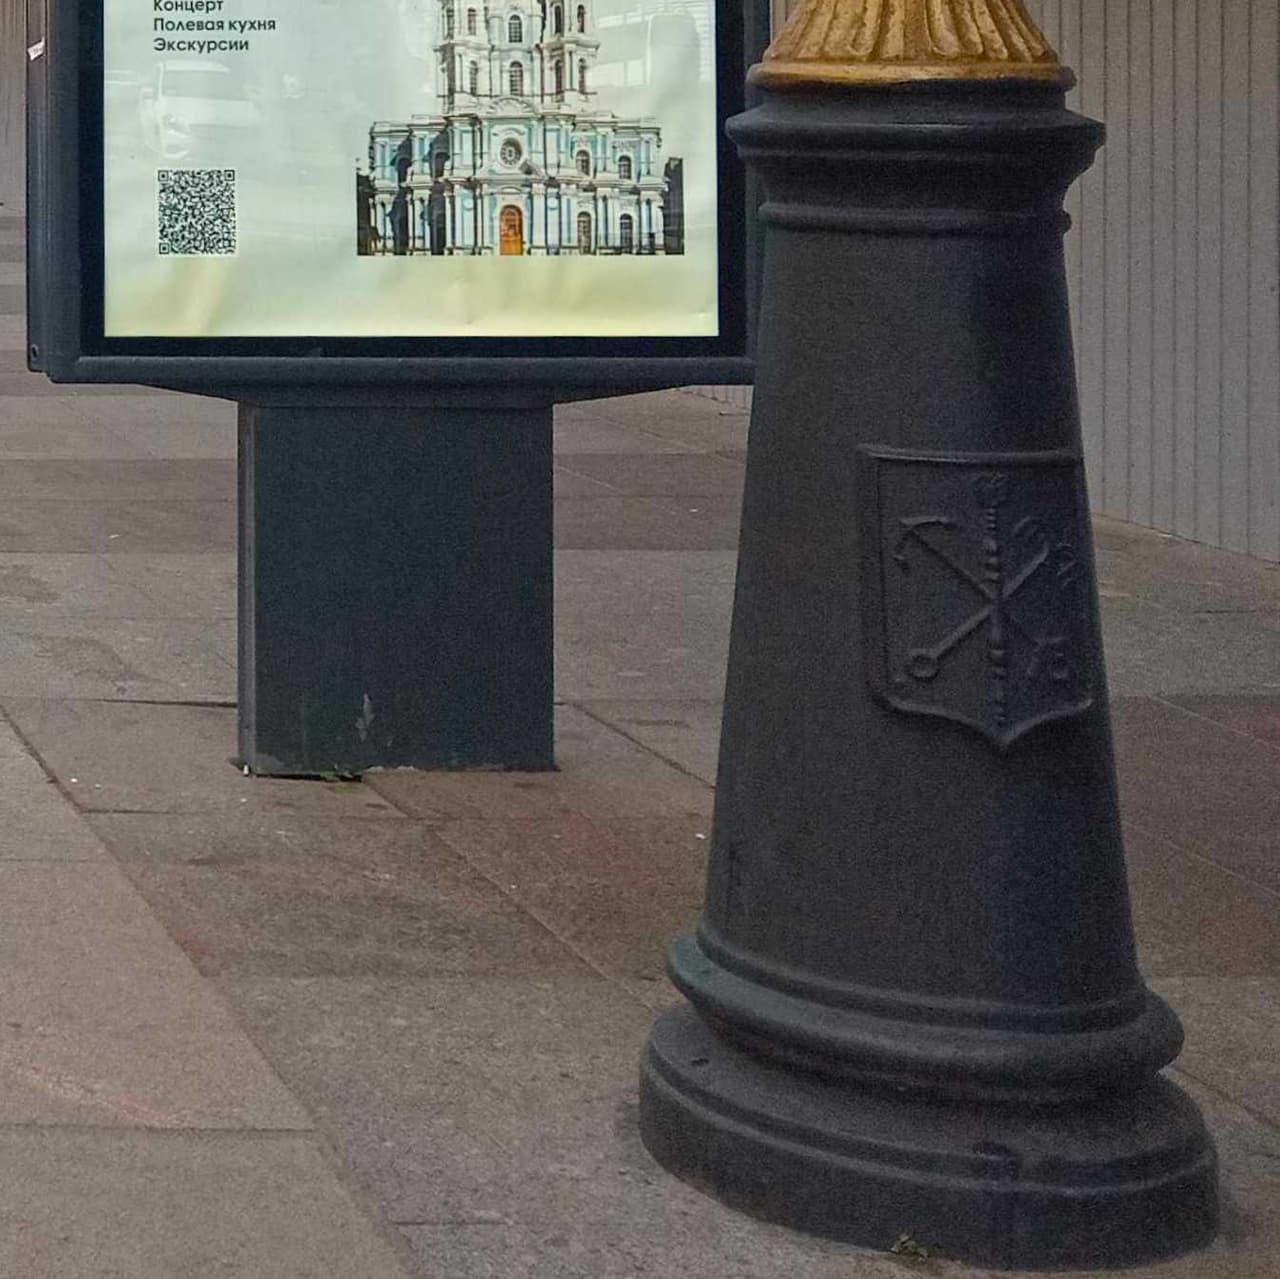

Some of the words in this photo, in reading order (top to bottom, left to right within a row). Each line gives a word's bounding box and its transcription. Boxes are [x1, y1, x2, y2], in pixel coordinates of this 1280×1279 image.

[152, 18, 224, 32] Полевая
[228, 19, 277, 34] кухня
[152, 37, 250, 55] Экскурсии
